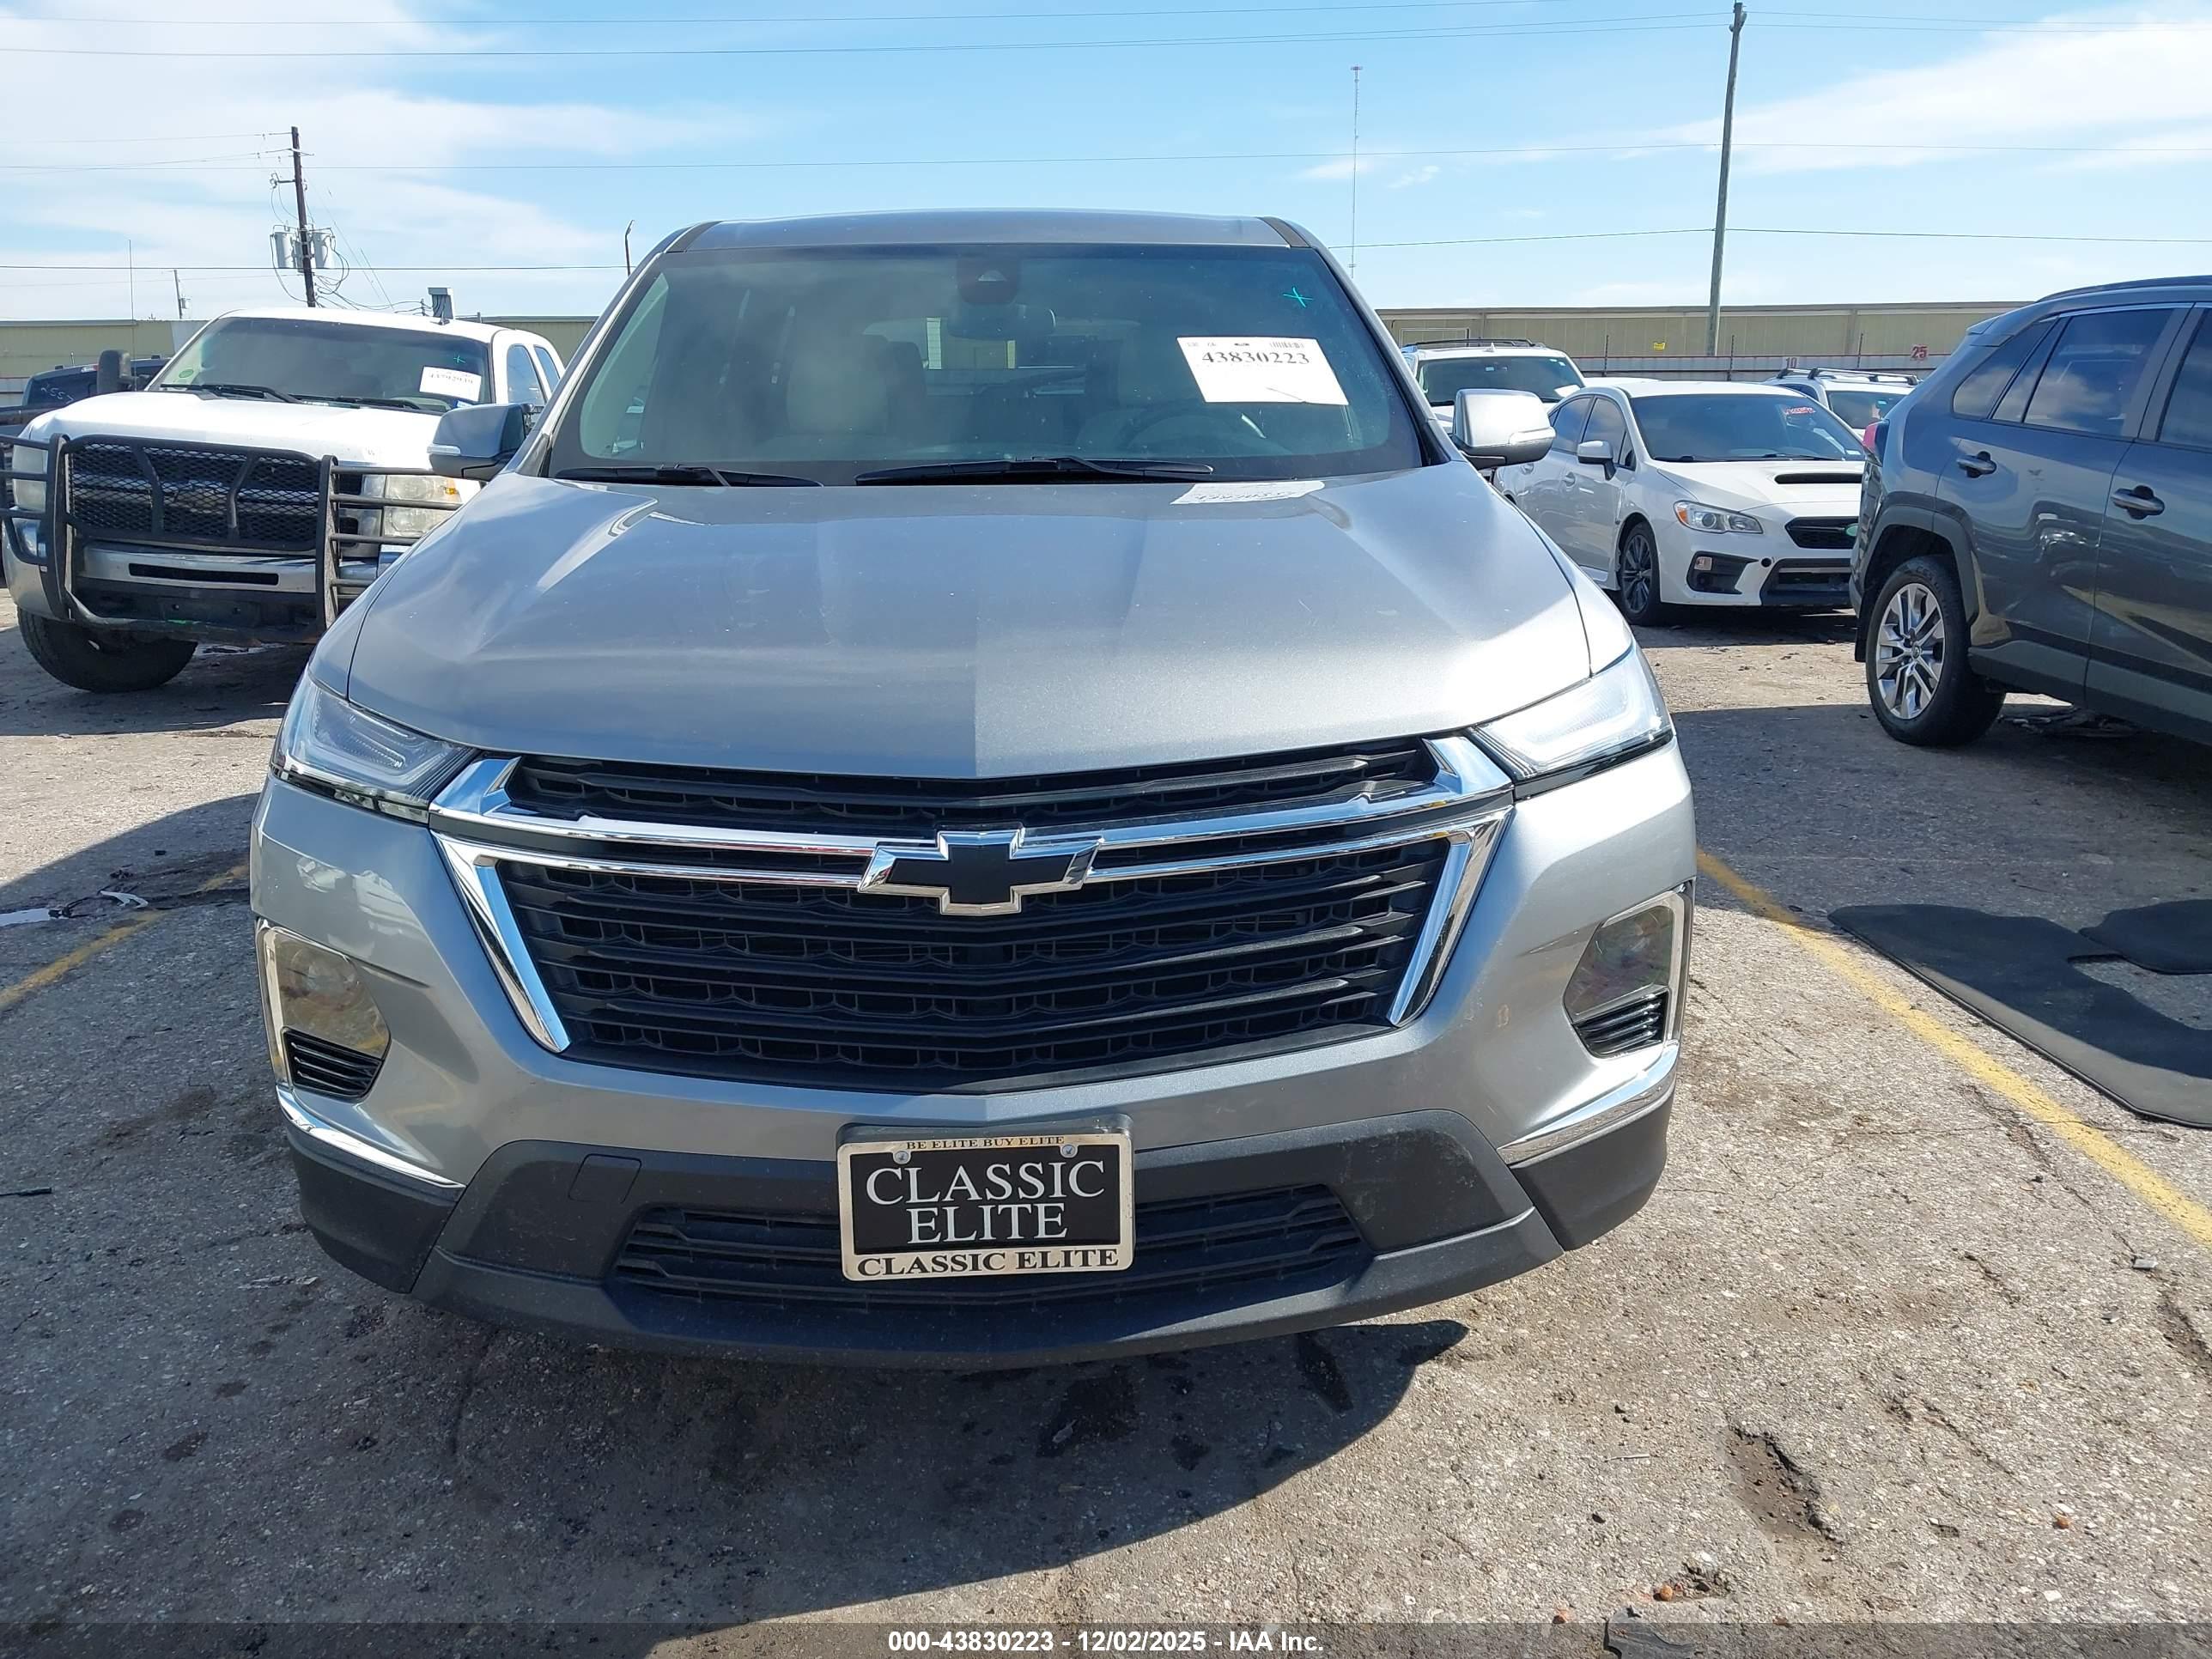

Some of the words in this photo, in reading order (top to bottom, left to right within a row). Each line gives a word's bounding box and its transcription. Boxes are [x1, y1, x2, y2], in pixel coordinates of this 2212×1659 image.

[1202, 351, 1310, 364] 43830223
[1911, 346, 1928, 359] 25
[1785, 357, 1797, 368] 10
[933, 1139, 977, 1148] ELITE
[982, 1138, 1014, 1146] BUY
[1018, 1136, 1065, 1146] ELITE
[866, 1160, 1105, 1206] CLASSIC
[906, 1203, 1067, 1244] ELITE
[858, 1252, 1006, 1277] CLASSIC
[1016, 1248, 1119, 1269] ELITE
